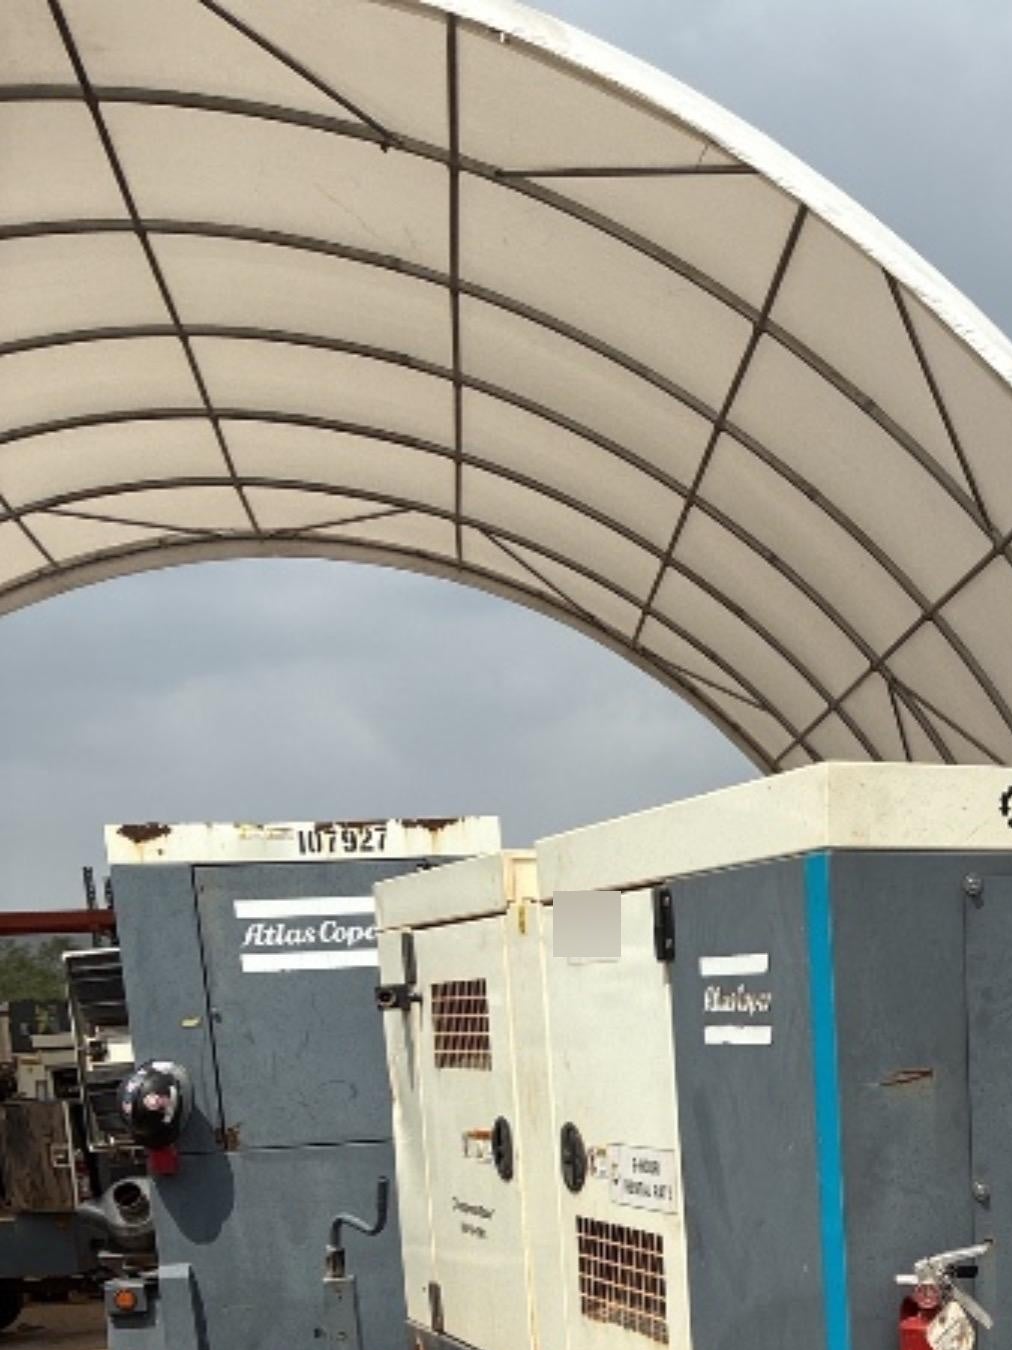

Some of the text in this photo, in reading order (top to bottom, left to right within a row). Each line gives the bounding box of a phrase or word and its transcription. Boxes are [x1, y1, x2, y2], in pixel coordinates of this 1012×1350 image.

[298, 826, 386, 855] 107927
[241, 919, 378, 948] Atlas Copc
